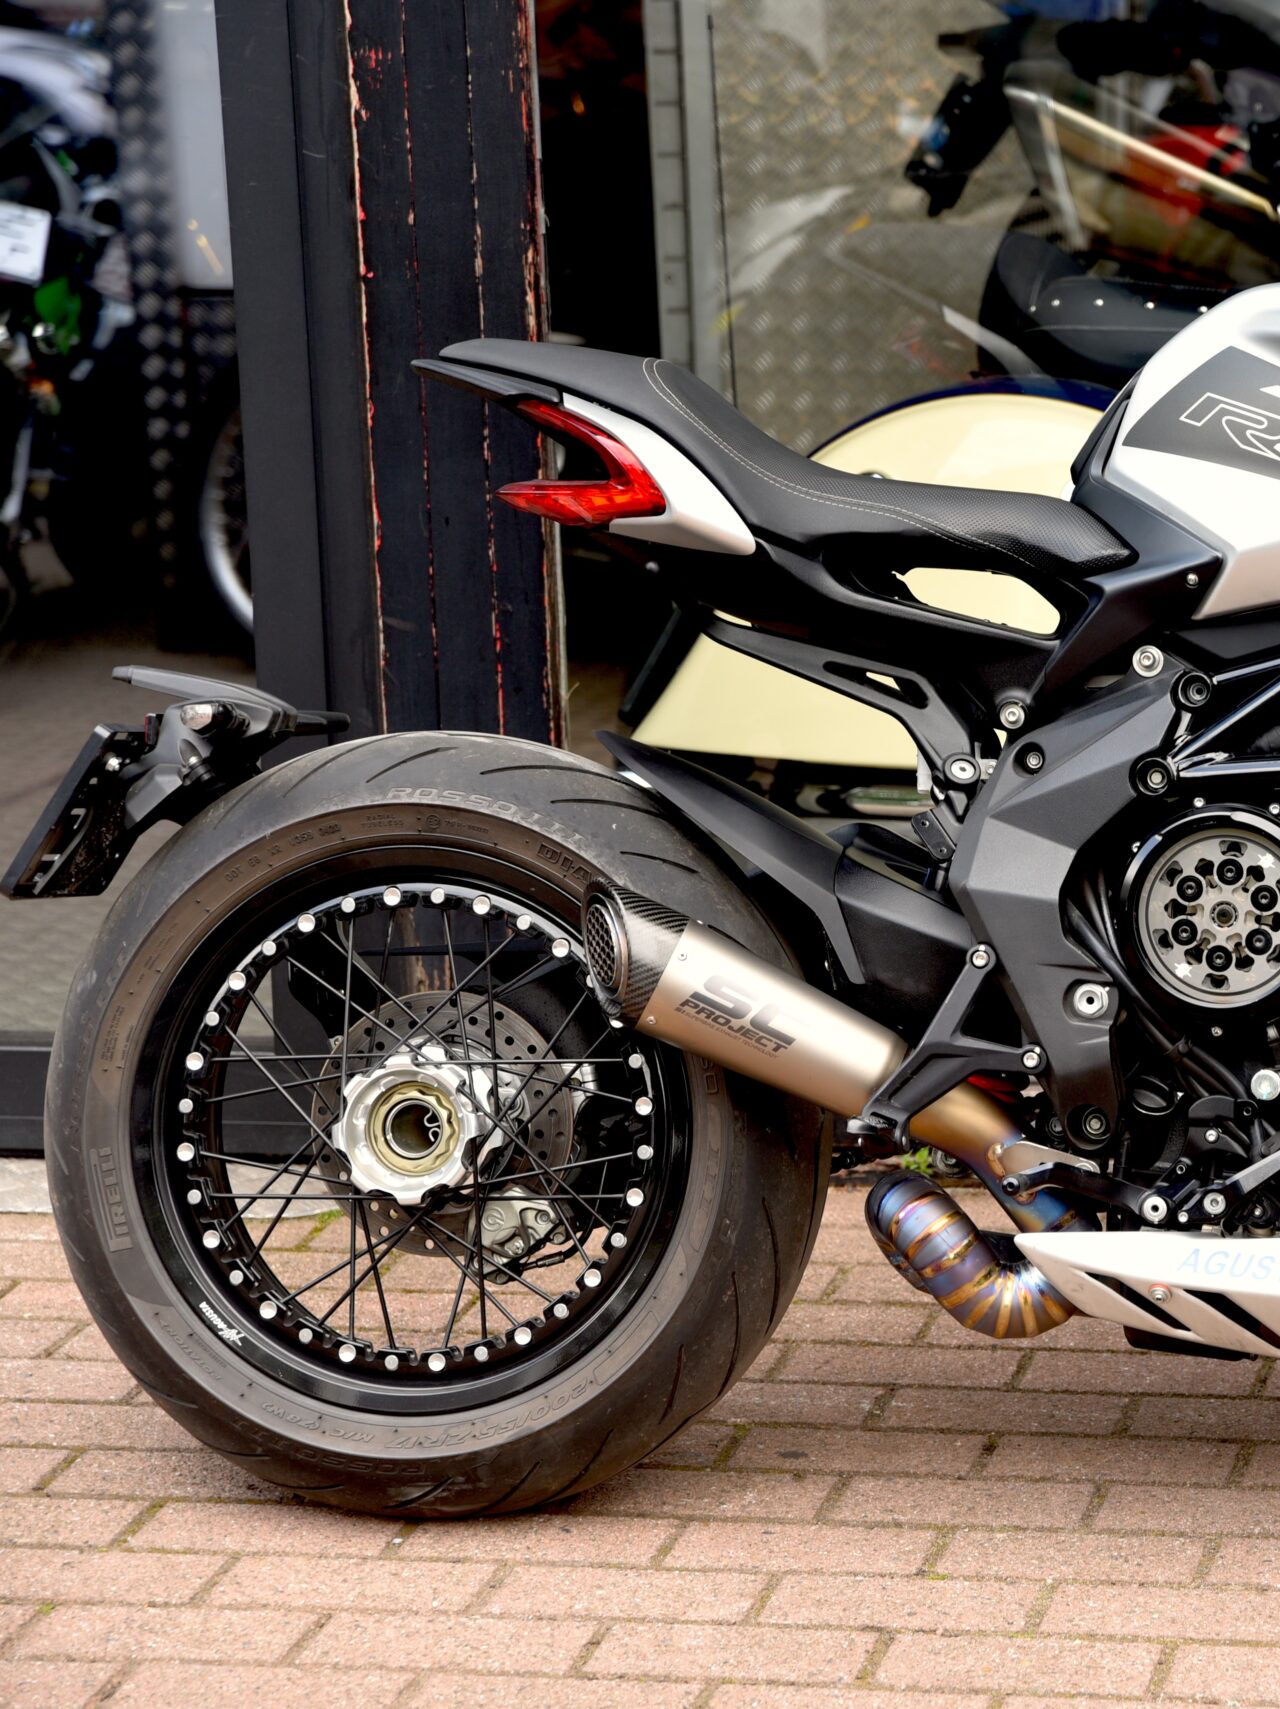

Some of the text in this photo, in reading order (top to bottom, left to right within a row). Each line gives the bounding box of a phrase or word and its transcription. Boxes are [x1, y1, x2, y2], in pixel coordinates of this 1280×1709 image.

[385, 787, 518, 815] ROSSO
[679, 998, 789, 1053] PROJECT
[689, 975, 797, 1047] SC
[90, 1147, 134, 1252] PIRELLI
[199, 1301, 227, 1329] AGUSTA
